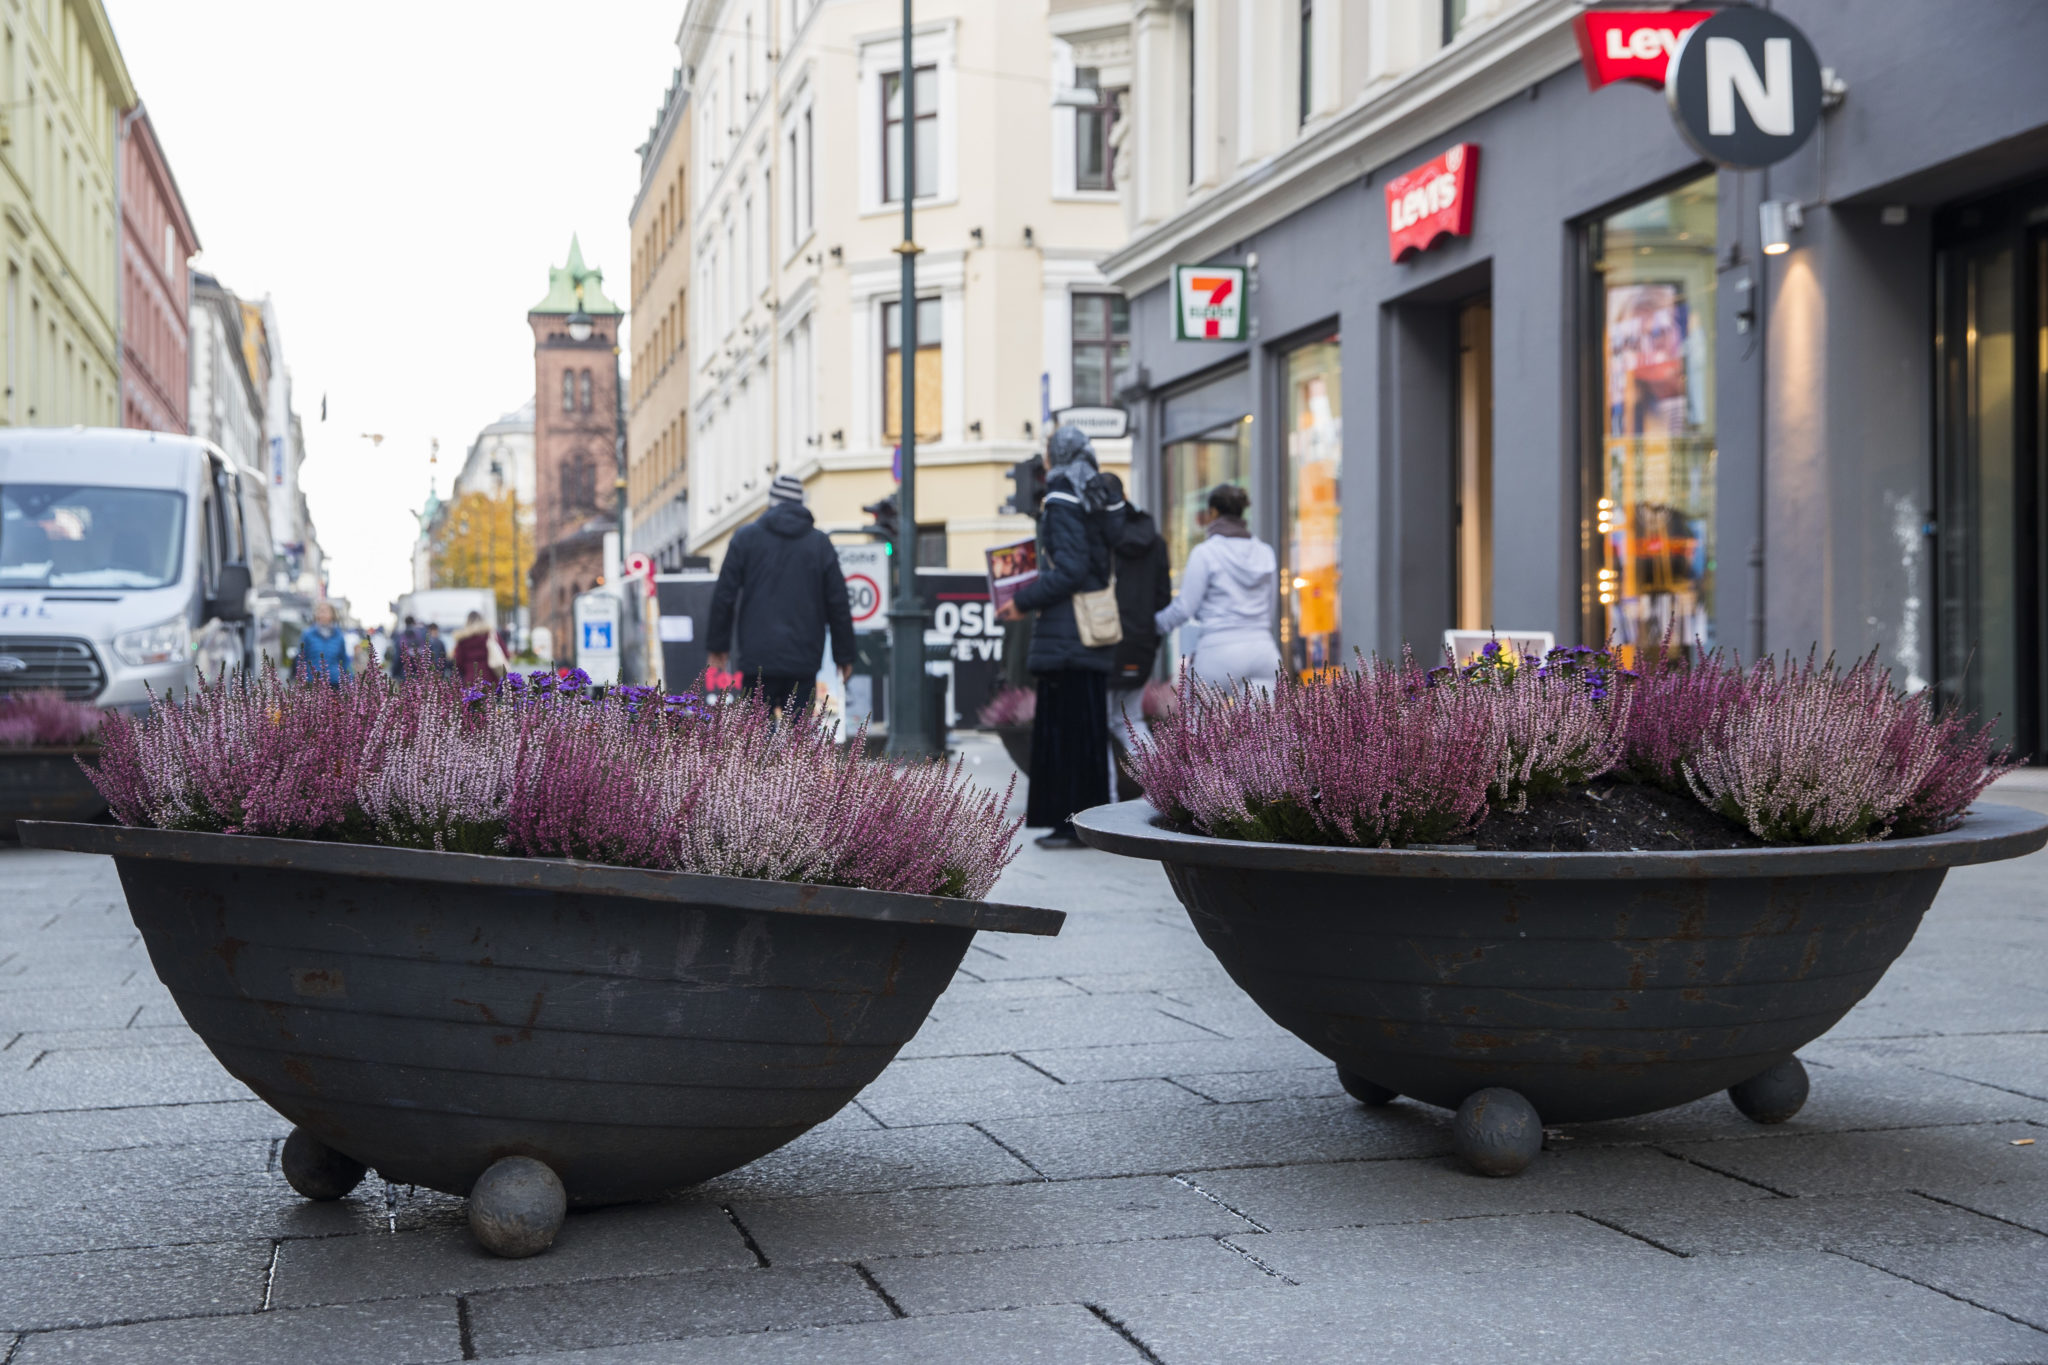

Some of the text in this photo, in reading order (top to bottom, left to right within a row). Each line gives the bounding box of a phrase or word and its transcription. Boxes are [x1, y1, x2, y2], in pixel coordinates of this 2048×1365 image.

[1705, 37, 1795, 136] N
[1191, 277, 1233, 339] 7
[934, 601, 1006, 637] OSL
